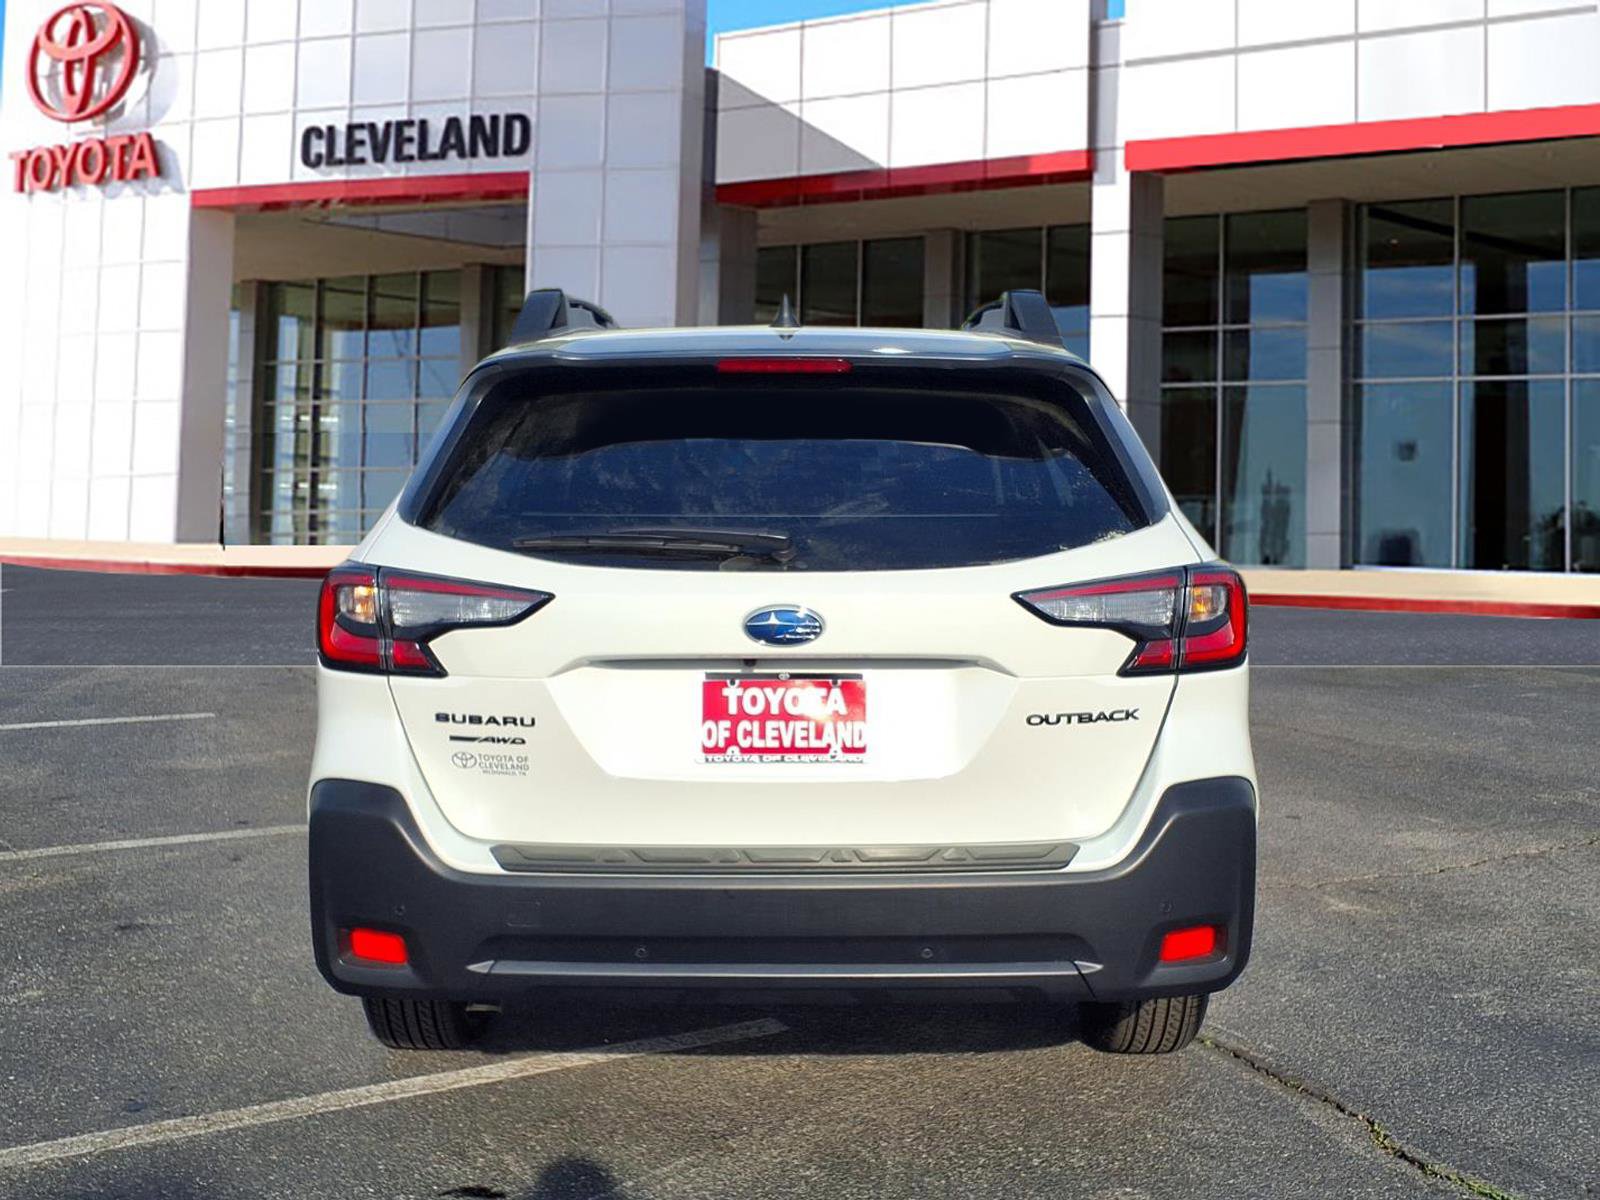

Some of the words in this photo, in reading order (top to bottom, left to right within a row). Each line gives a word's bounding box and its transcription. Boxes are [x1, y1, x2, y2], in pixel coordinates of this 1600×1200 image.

[301, 113, 531, 169] CLEVELAND
[9, 132, 160, 193] TOYOTA
[722, 687, 848, 715] TOYOTA
[435, 712, 535, 727] SUBARU
[1026, 708, 1139, 726] OUTBACK
[478, 736, 526, 745] AWD
[702, 720, 731, 748] OF
[736, 720, 866, 748] CLEVELAND
[478, 753, 514, 763] TOYOTA
[516, 755, 528, 764] OF
[478, 761, 530, 771] CLEVELAND
[705, 754, 759, 763] TOYOTA
